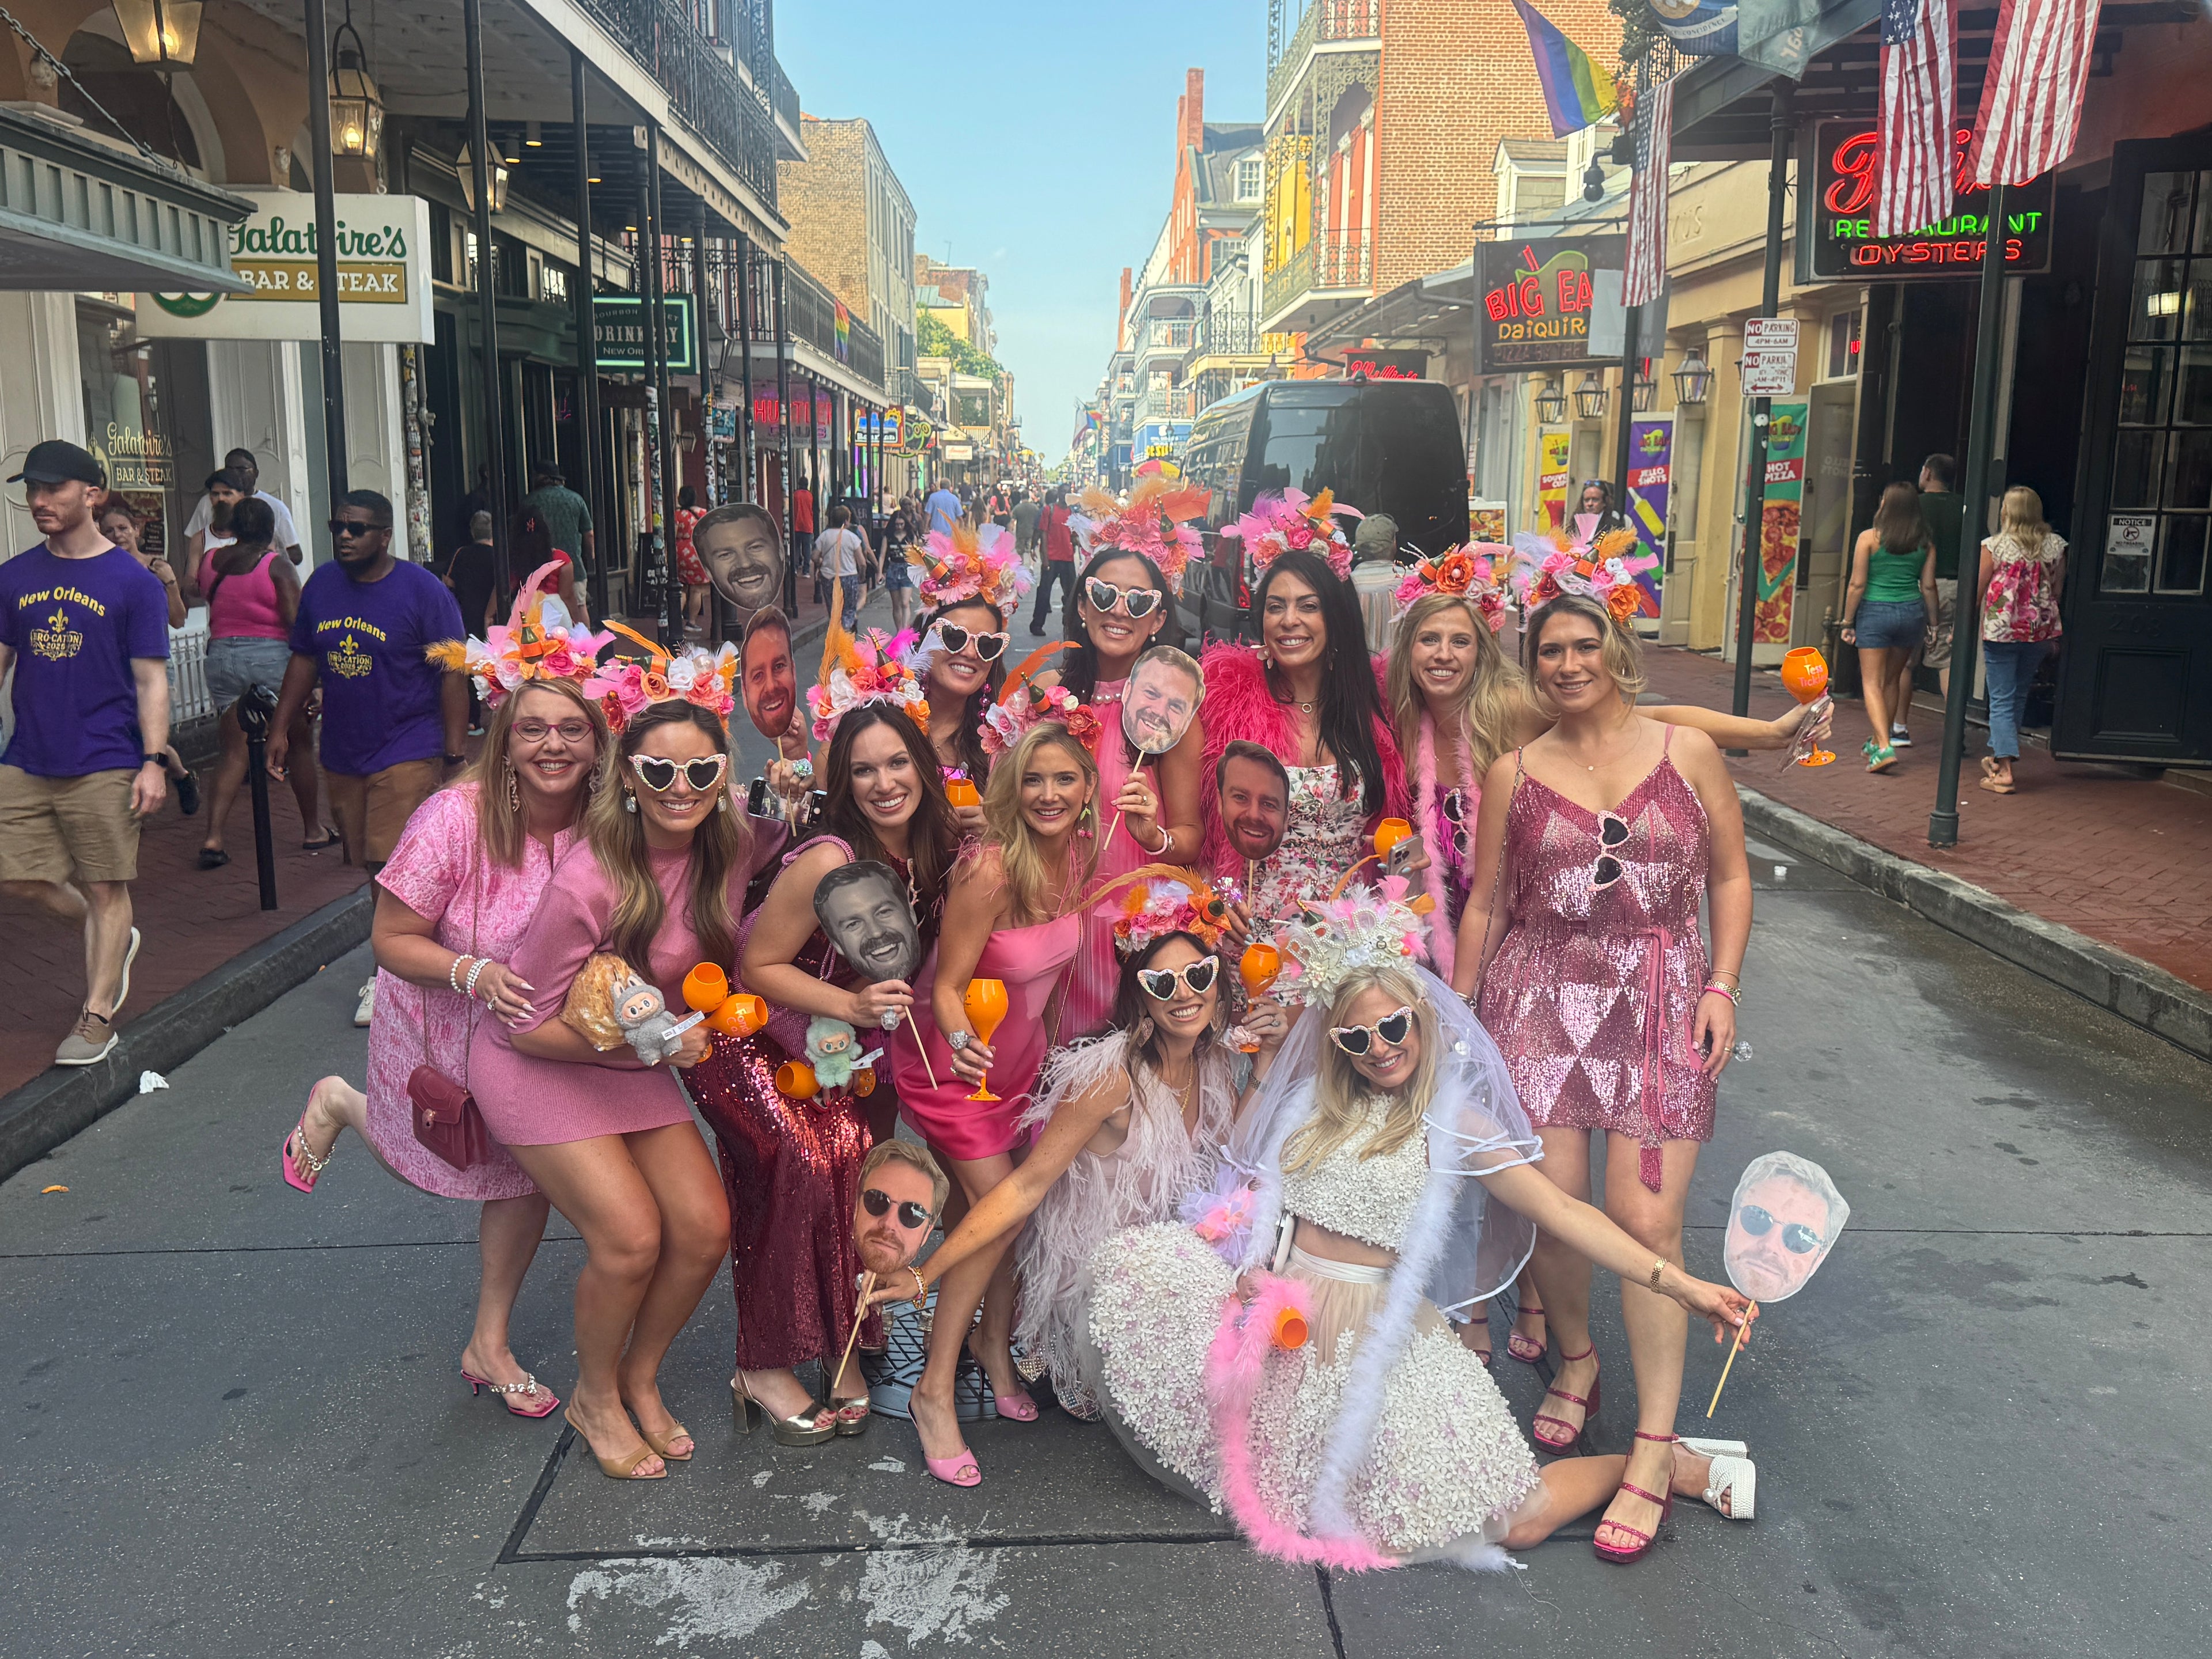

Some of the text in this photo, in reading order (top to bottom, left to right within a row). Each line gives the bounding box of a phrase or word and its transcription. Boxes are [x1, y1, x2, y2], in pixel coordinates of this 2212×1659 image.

[239, 270, 399, 292] BAR & TEAK
[1484, 270, 1594, 321] BIG EA
[1747, 323, 1795, 334] NO PARKING
[603, 347, 626, 355] NEW
[1744, 355, 1760, 366] NO
[107, 421, 173, 457] Galatoire's
[1641, 467, 1665, 478] JELLO
[1767, 461, 1791, 474] HOT
[116, 467, 172, 485] BAR & STEAK
[1638, 474, 1667, 486] SHOTS
[1764, 472, 1796, 483] PIZZA
[19, 586, 105, 618] New Orleans
[316, 616, 386, 642] New Orleans
[1803, 664, 1824, 676] Tess
[1285, 900, 1412, 969] BRIDE
